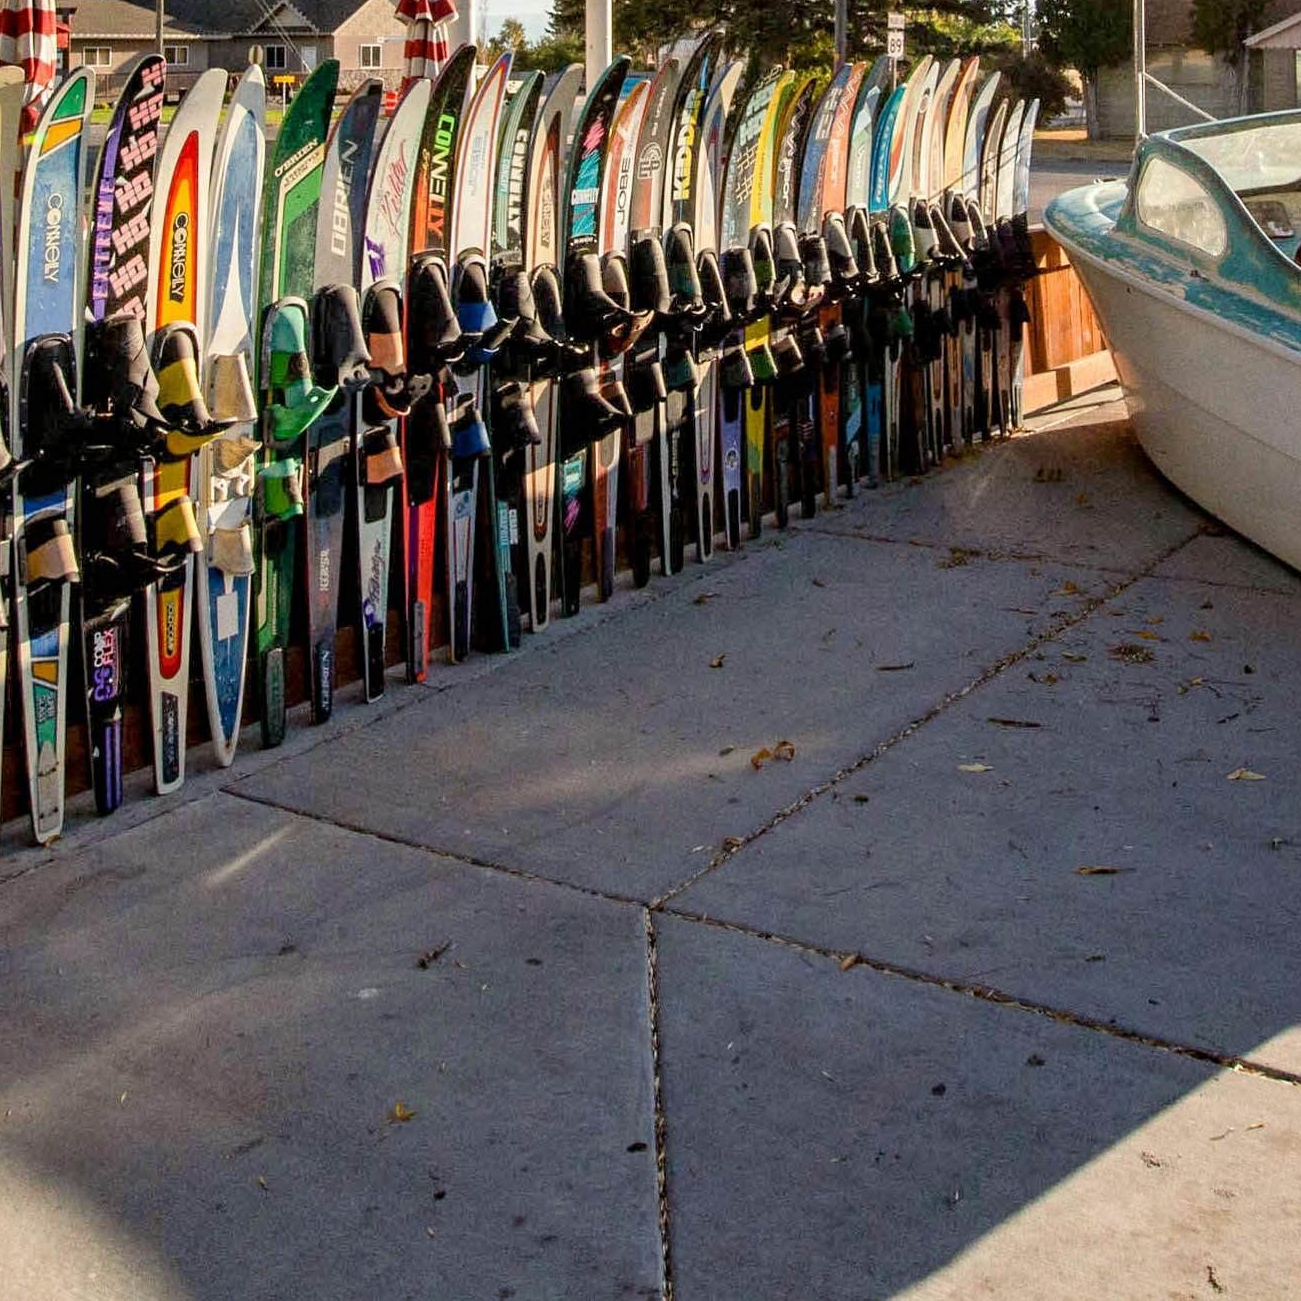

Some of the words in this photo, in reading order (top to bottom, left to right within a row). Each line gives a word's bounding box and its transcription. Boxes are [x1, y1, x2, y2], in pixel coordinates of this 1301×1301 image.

[889, 38, 903, 54] 89
[427, 114, 456, 237] CONNELLY
[672, 88, 702, 201] KIDDER
[617, 157, 632, 226] JOBE
[93, 178, 116, 300] EXTREME
[93, 630, 104, 669] COMP
[103, 628, 116, 666] FLEX
